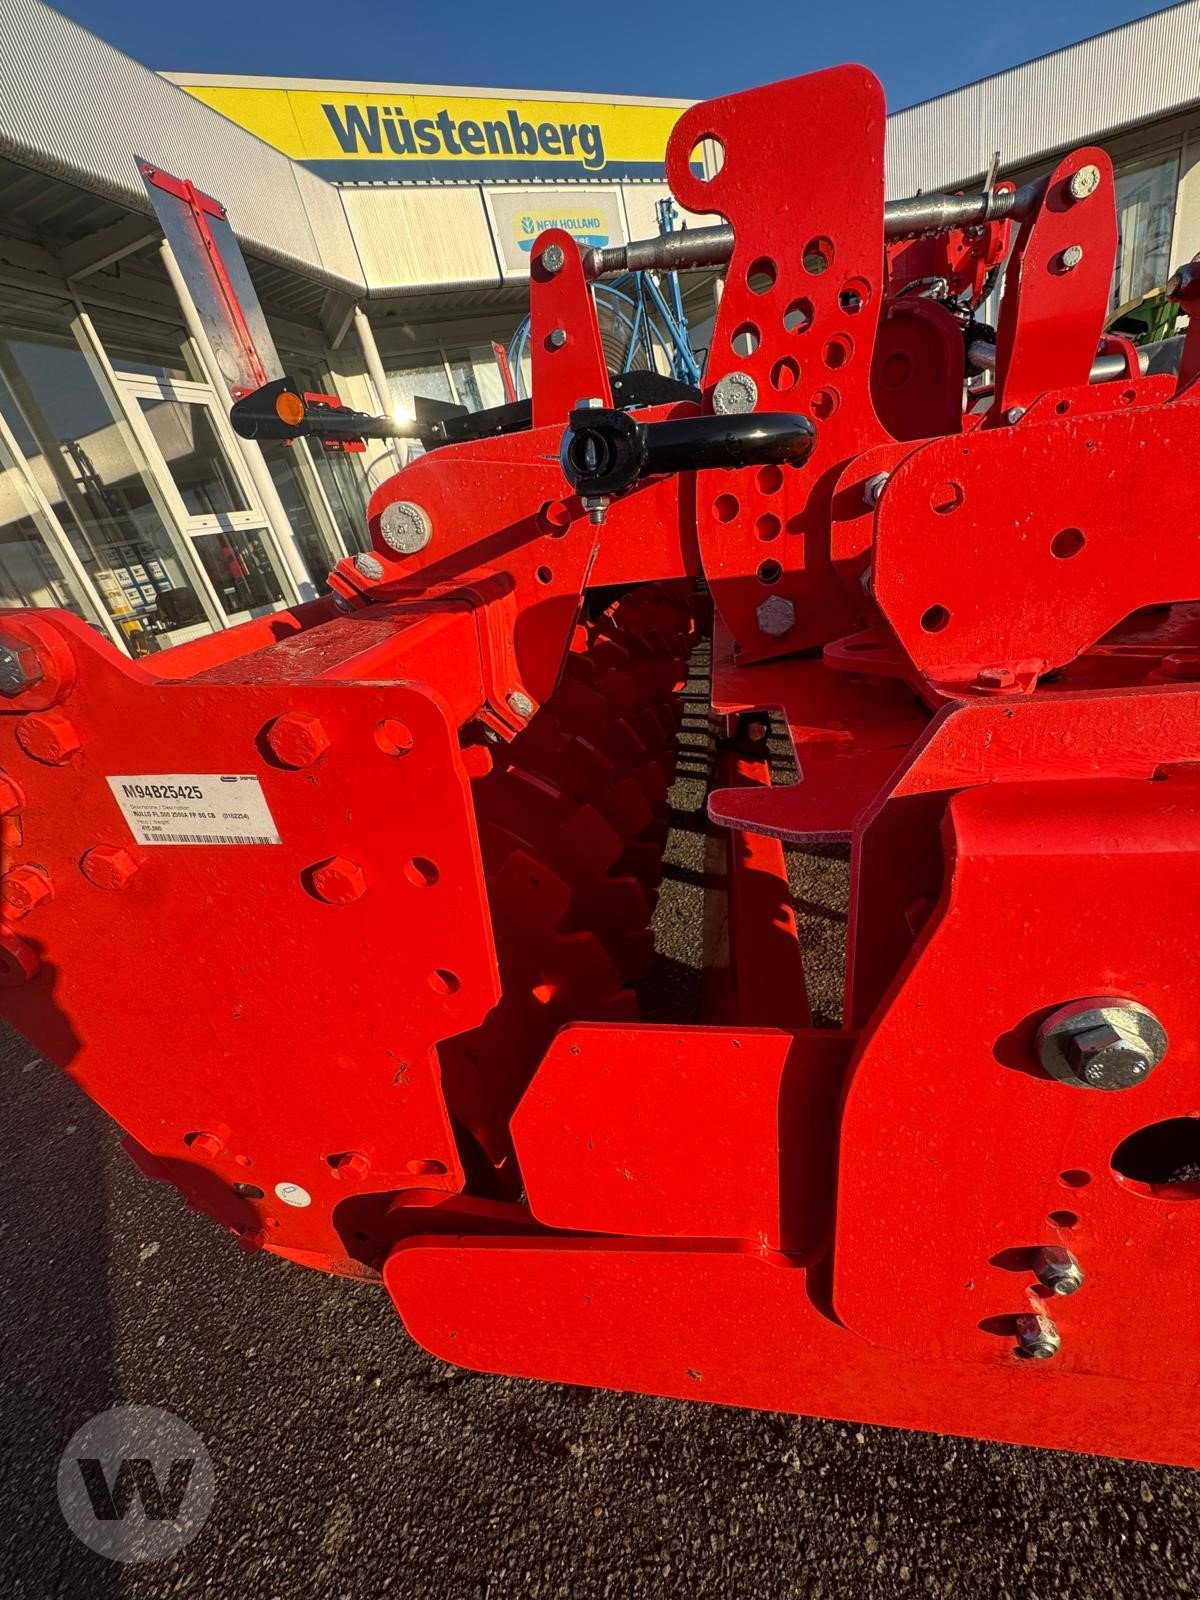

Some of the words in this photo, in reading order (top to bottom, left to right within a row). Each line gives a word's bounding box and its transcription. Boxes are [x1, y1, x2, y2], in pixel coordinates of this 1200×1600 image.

[321, 103, 606, 169] Wüstenberg
[536, 219, 558, 231] NEW
[560, 218, 600, 229] HOLLAND
[122, 784, 203, 799] M94B25425
